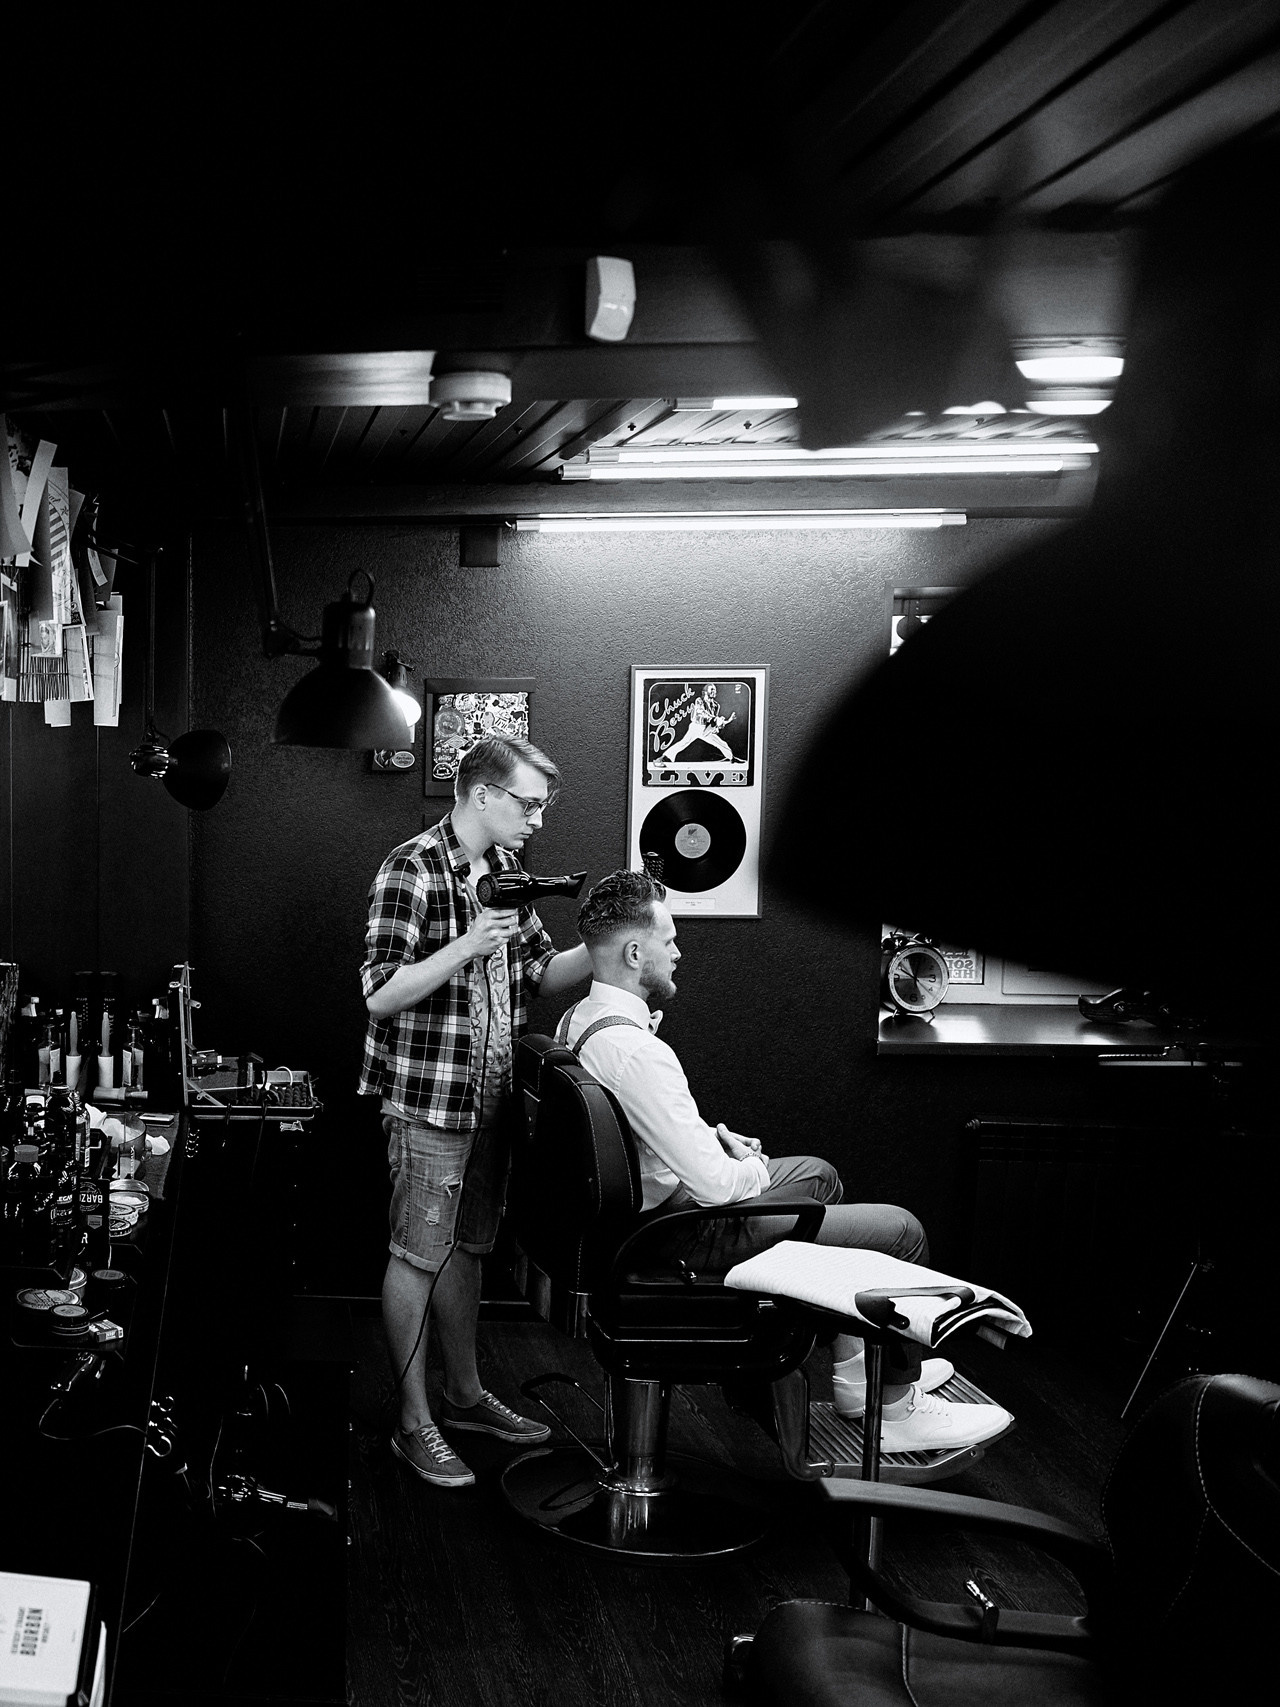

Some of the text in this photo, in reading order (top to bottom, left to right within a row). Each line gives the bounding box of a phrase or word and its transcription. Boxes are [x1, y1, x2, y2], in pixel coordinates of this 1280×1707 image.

[649, 683, 695, 726] Chuck
[649, 702, 697, 753] Berry
[647, 769, 748, 786] LIVE
[20, 1607, 43, 1656] BOURBON
